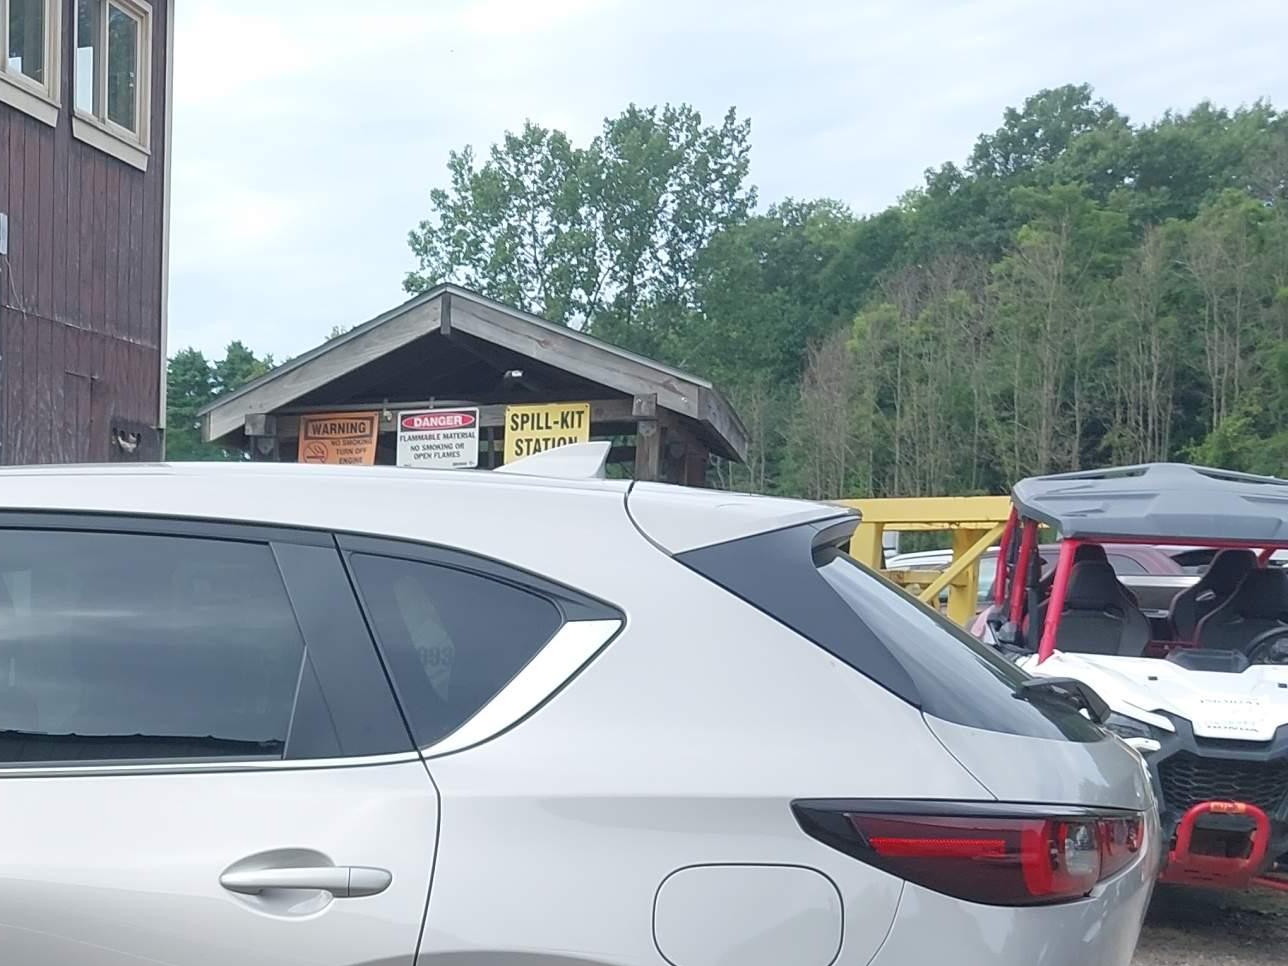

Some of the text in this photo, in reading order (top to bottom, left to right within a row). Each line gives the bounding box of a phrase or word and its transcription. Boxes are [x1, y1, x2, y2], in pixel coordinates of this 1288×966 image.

[413, 415, 463, 427] DANGER
[510, 410, 585, 431] SPILL-KIT
[312, 421, 366, 435] WARNING
[400, 431, 476, 442] FLAMMABLE MATERIAL
[336, 447, 366, 456] TURN OFF
[421, 443, 453, 451] SMOKING
[413, 450, 461, 460] OPEN FLAMES
